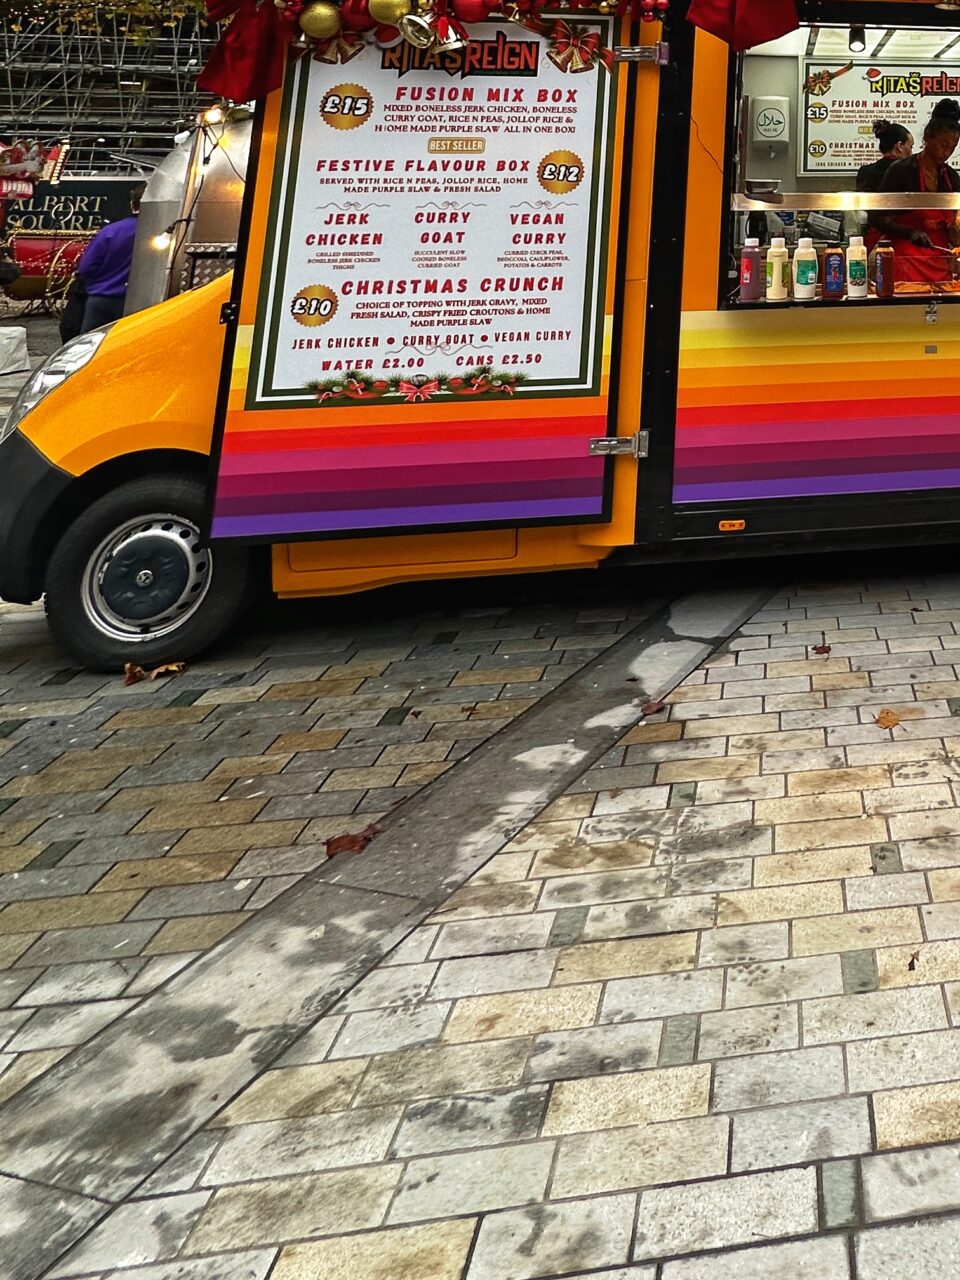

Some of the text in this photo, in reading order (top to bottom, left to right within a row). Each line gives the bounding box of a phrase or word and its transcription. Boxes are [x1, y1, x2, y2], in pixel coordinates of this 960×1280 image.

[464, 32, 536, 72] REIGN
[872, 76, 920, 94] RITA'S
[395, 86, 578, 103] FUSION MIX BOX
[322, 96, 369, 117] £15
[383, 104, 578, 115] MIXED BONELESS JERK CHICKEN, BONELESS
[831, 100, 868, 108] FUSION
[872, 100, 890, 108] MIX
[384, 114, 416, 123] CURRY
[418, 114, 446, 124] GOAT,
[448, 115, 471, 123] RICE
[472, 115, 479, 123] N
[480, 115, 504, 124] PEAS,
[505, 115, 540, 124] JOLLOF
[542, 116, 563, 124] RICE
[806, 107, 828, 118] £15
[410, 125, 437, 133] MADE
[439, 125, 474, 133] PURPLE
[475, 125, 500, 133] SLAW
[503, 125, 521, 134] ALL
[522, 126, 532, 134] IN
[533, 126, 553, 134] ONE
[430, 140, 483, 151] BEST SELLER
[808, 145, 826, 153] £10
[316, 159, 531, 172] FESTIVE FLAVOUR BOX
[541, 164, 581, 182] £12
[319, 177, 355, 185] SERVED
[357, 177, 381, 185] WITH
[323, 213, 370, 225] JERK
[413, 212, 471, 224] CURRY
[508, 213, 565, 225] VEGAN
[305, 233, 384, 246] CHICKEN
[420, 231, 466, 244] GOAT
[511, 232, 568, 245] CURRY
[340, 276, 565, 296] CHRISTMAS CRUNCH
[290, 296, 334, 317] £10
[355, 298, 548, 310] CHOICE OF TOPPING WITH JERK GRAVY, MIXED
[350, 307, 551, 320] FRESH SALAD, CRISPY FRIED CROUTONS & HOME
[410, 318, 493, 327] MADE PURPLE SLAW
[291, 330, 572, 350] JERK CHICKEN CURRY GOAT VEGAN CURRY
[321, 353, 543, 371] WATER £2.00 CANS £2.50
